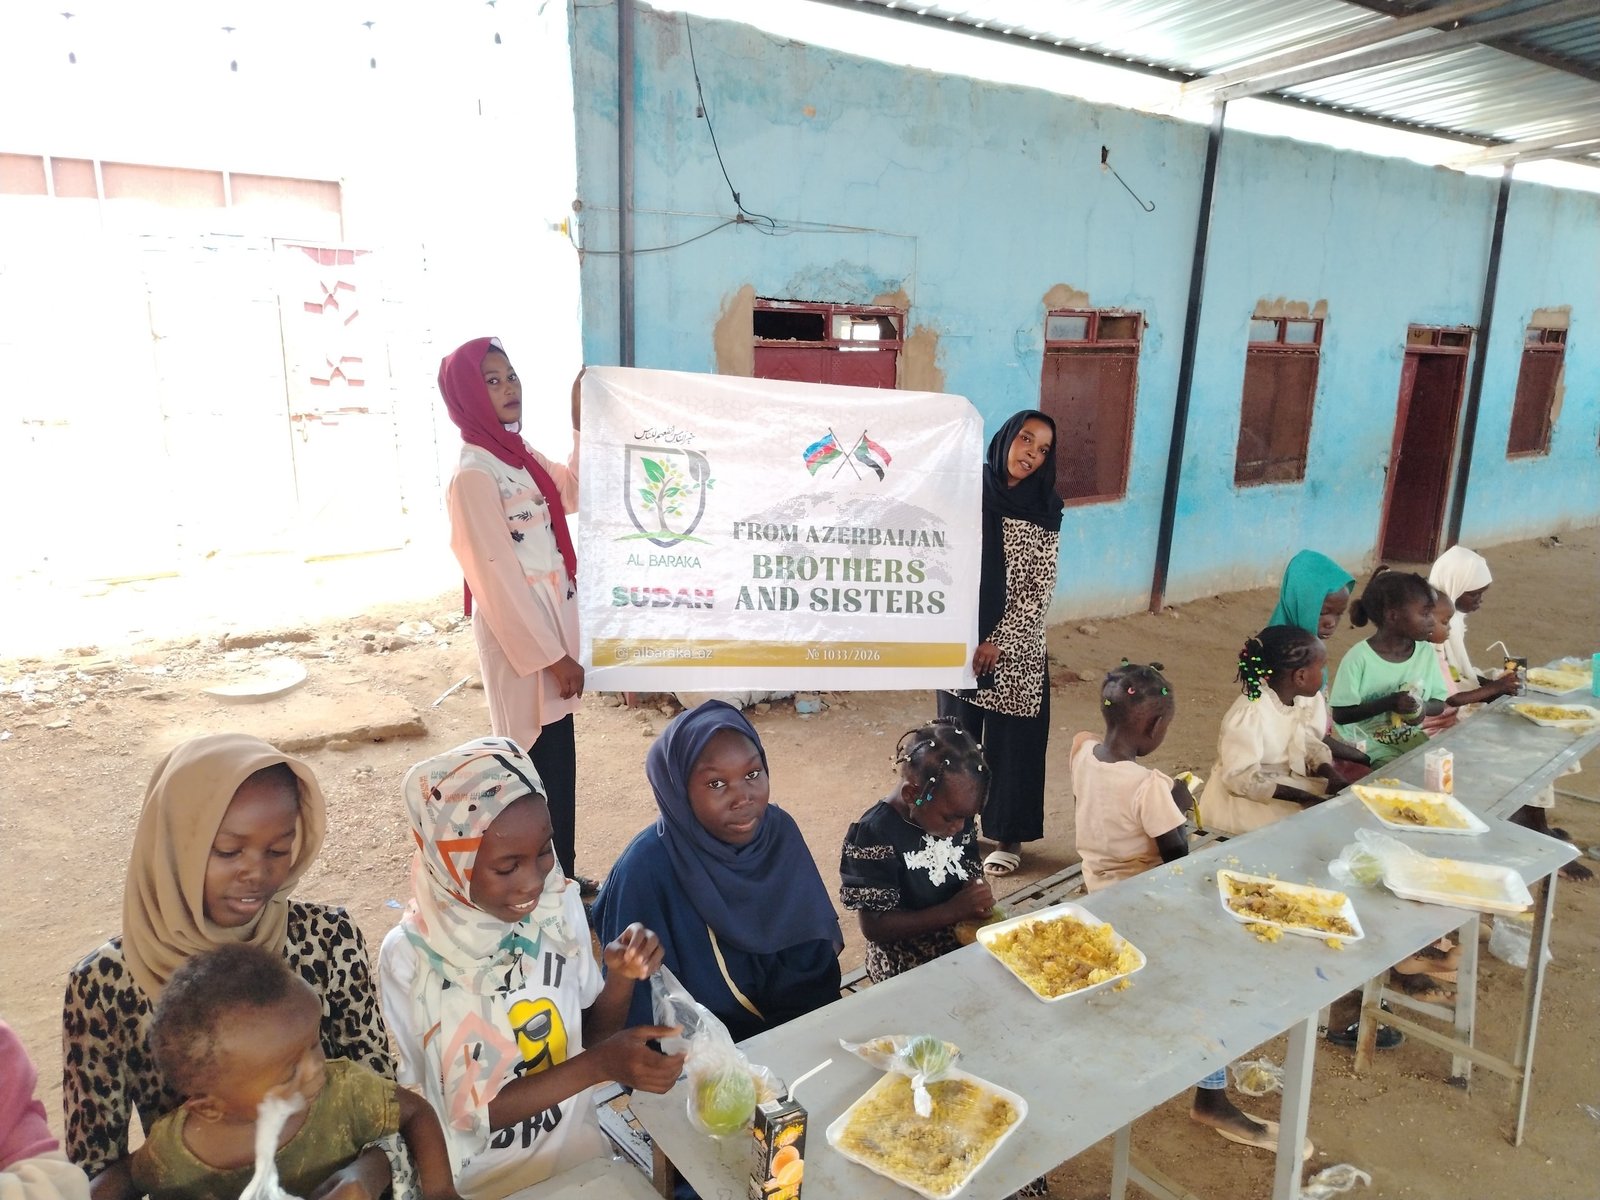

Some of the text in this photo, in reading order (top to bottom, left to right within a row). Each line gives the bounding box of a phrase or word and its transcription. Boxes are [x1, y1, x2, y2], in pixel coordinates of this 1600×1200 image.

[733, 521, 945, 548] FROM AZERBAIJAN
[626, 553, 702, 569] AL BARAKA
[752, 554, 926, 584] BROTHERS
[611, 586, 714, 609] SUDAN
[734, 585, 946, 615] AND SISTERS
[823, 649, 880, 661] 1033/2026
[543, 952, 566, 989] IT
